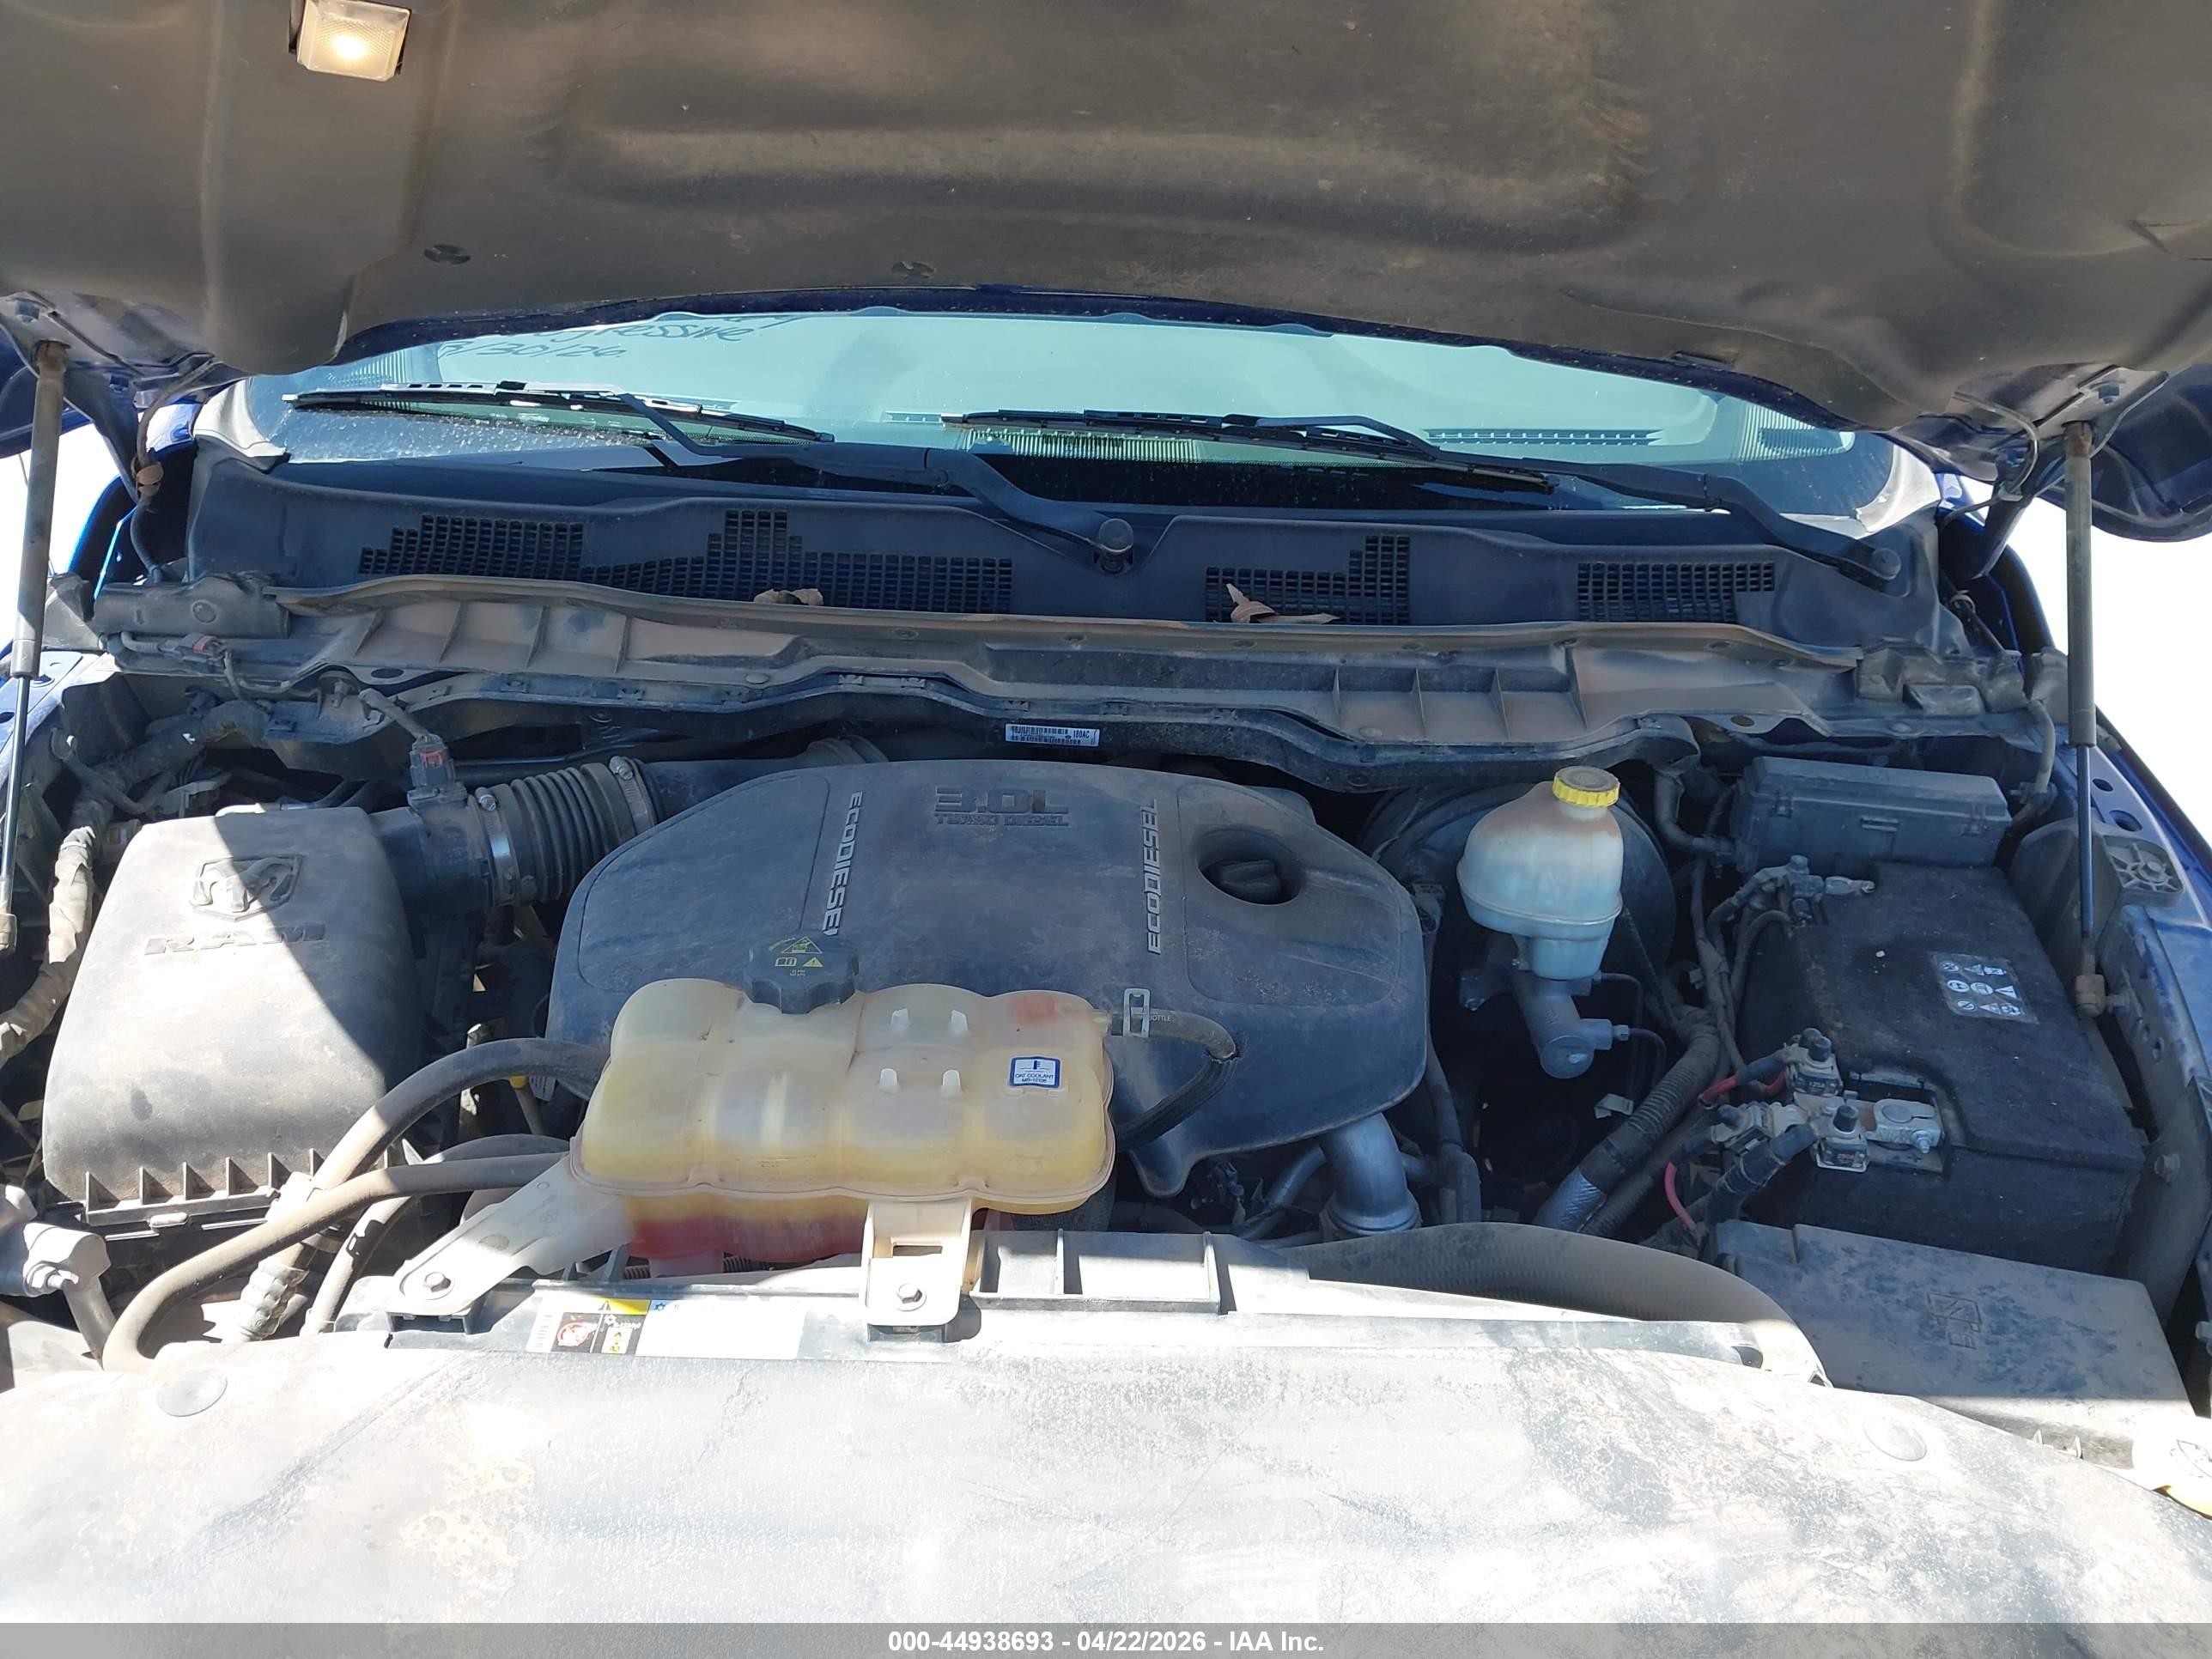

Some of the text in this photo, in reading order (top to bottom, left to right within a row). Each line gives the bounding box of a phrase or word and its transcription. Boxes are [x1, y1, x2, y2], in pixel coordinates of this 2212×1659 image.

[934, 787, 1069, 815] 3.0L
[822, 791, 863, 936] ECODIESEL
[1140, 799, 1161, 955] ECODIESEL
[144, 922, 328, 955] RAM
